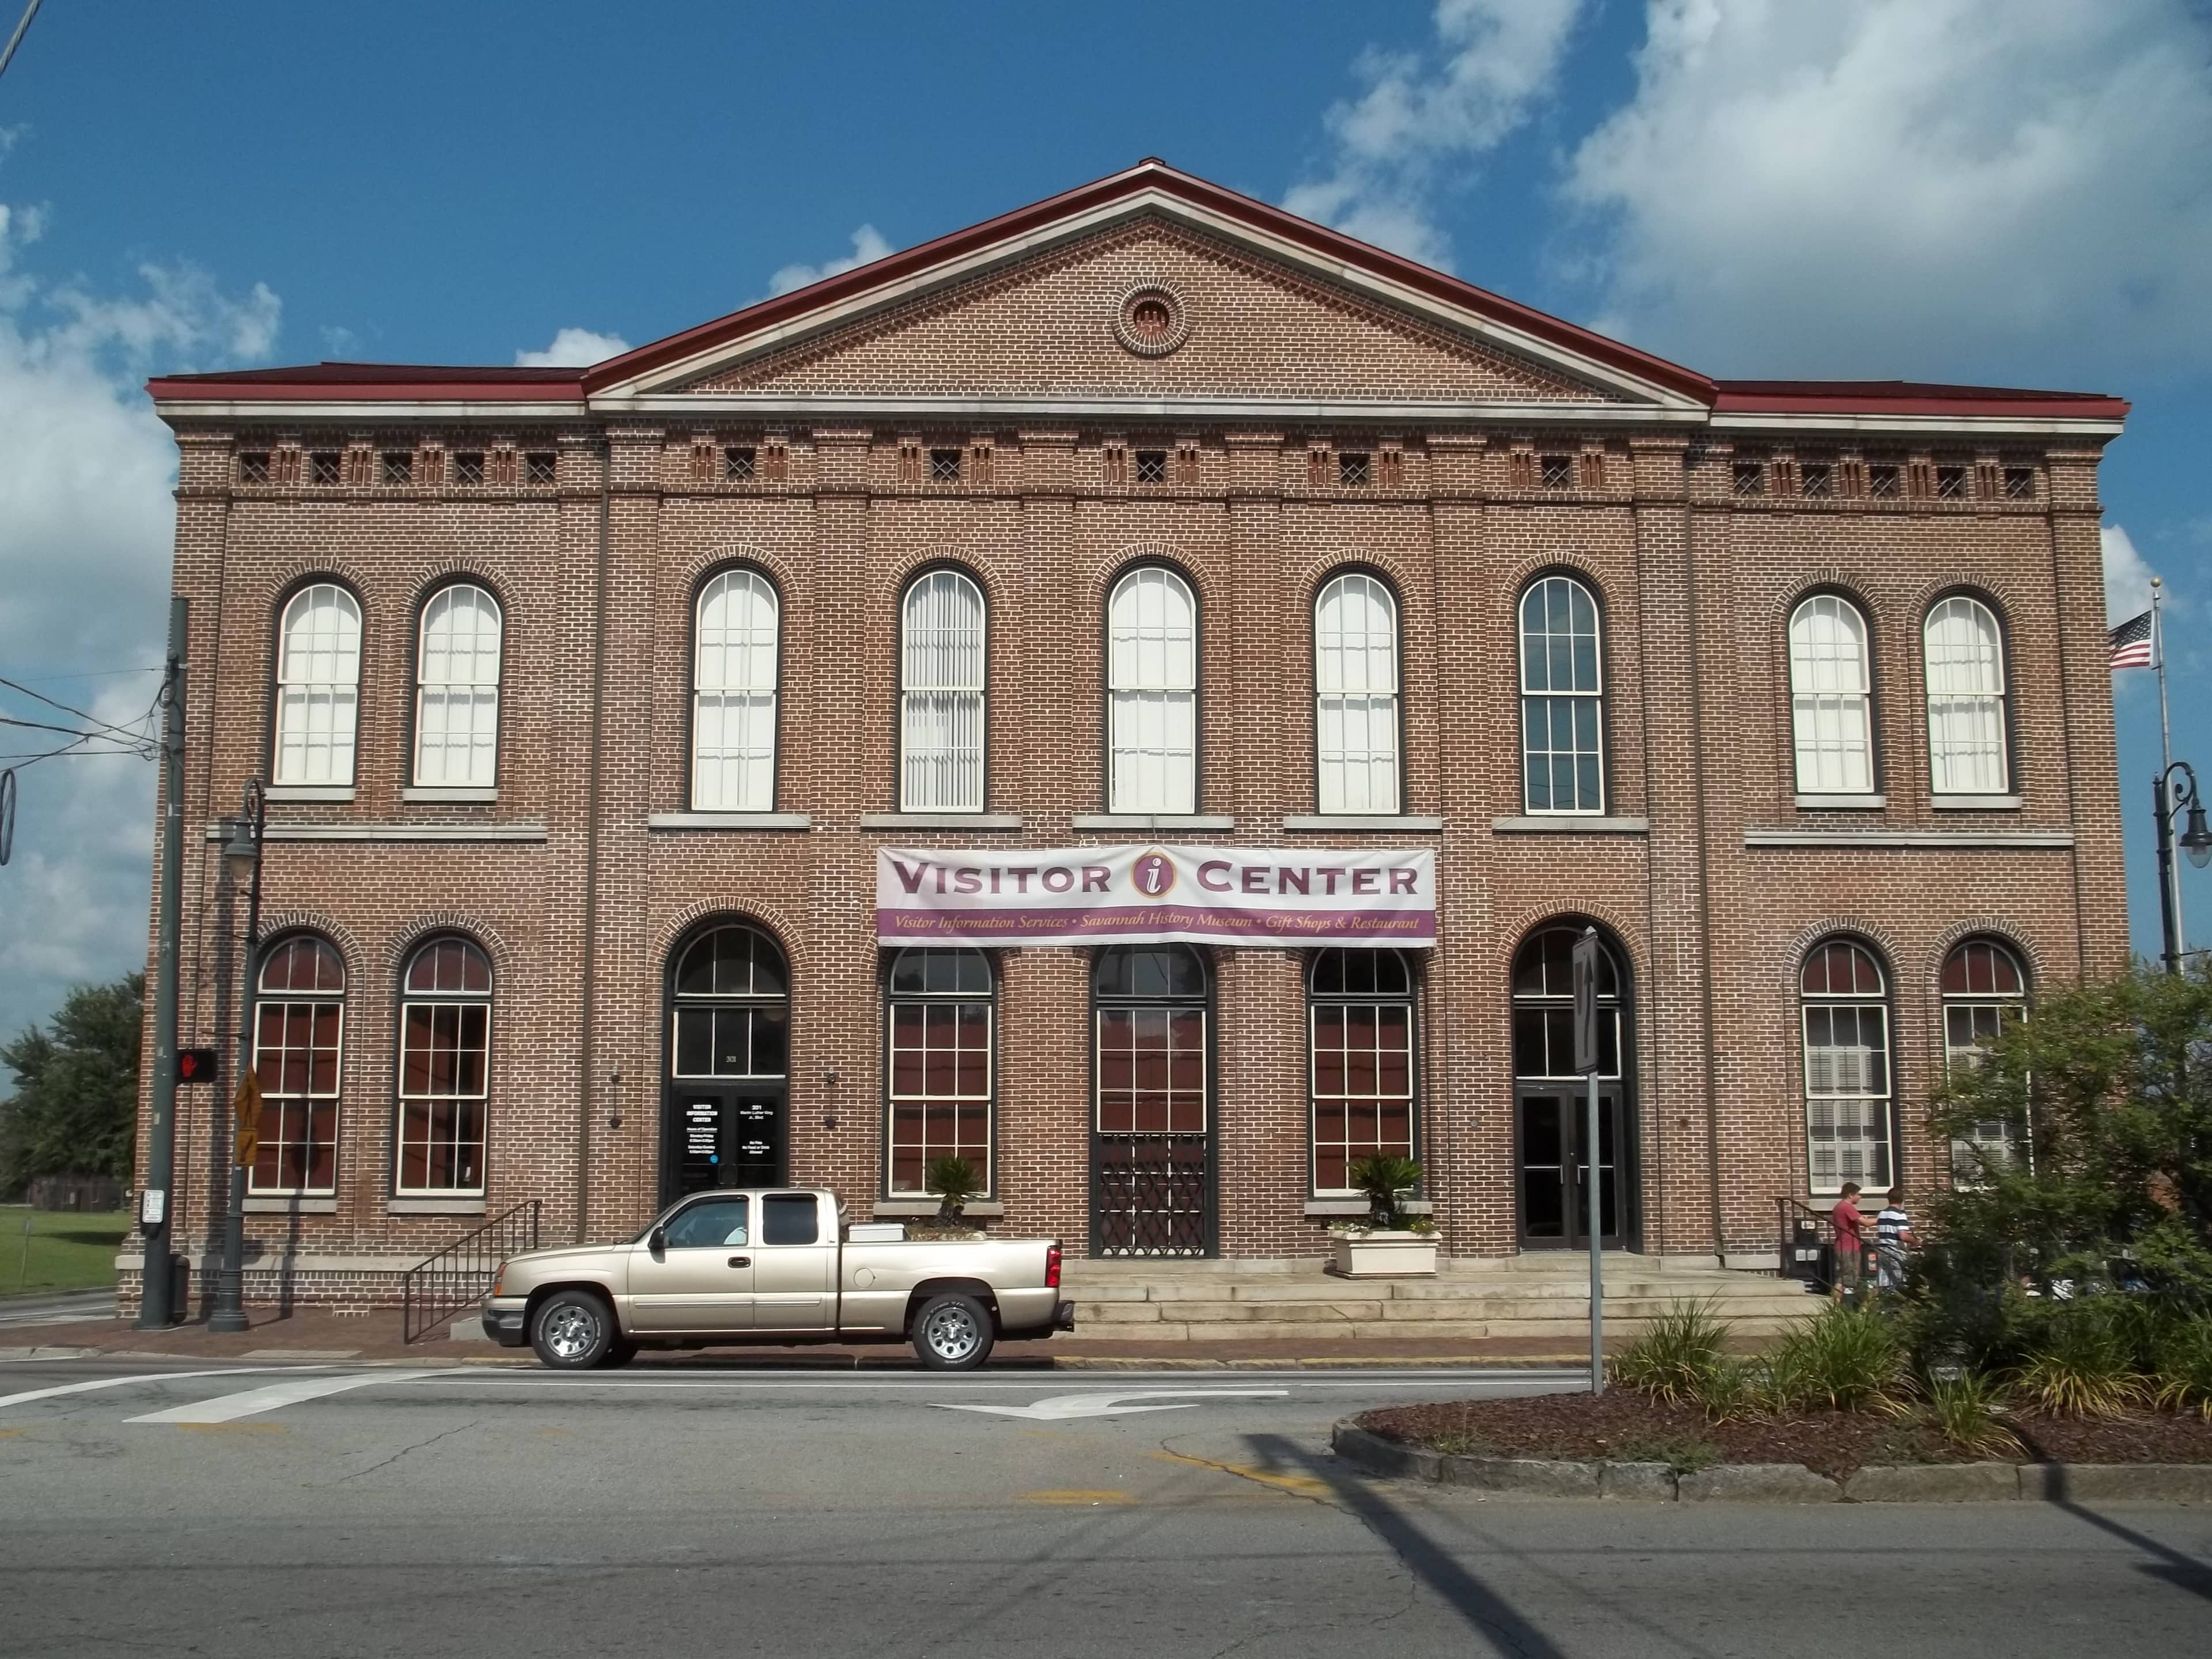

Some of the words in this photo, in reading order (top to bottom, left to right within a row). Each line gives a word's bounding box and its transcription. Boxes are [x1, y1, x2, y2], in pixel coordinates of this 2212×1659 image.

[892, 861, 1111, 894] VISITOR
[1197, 860, 1419, 895] CENTER
[895, 915, 936, 929] Visitor
[939, 915, 1014, 934] Information
[1018, 915, 1068, 929] Services
[1080, 911, 1146, 927] Savannah
[1148, 911, 1194, 929] History
[1198, 913, 1253, 927] Museum
[1266, 915, 1292, 933] Gift
[1294, 915, 1331, 933] Shops
[1335, 916, 1347, 929] &
[1351, 916, 1420, 930] Restaurant
